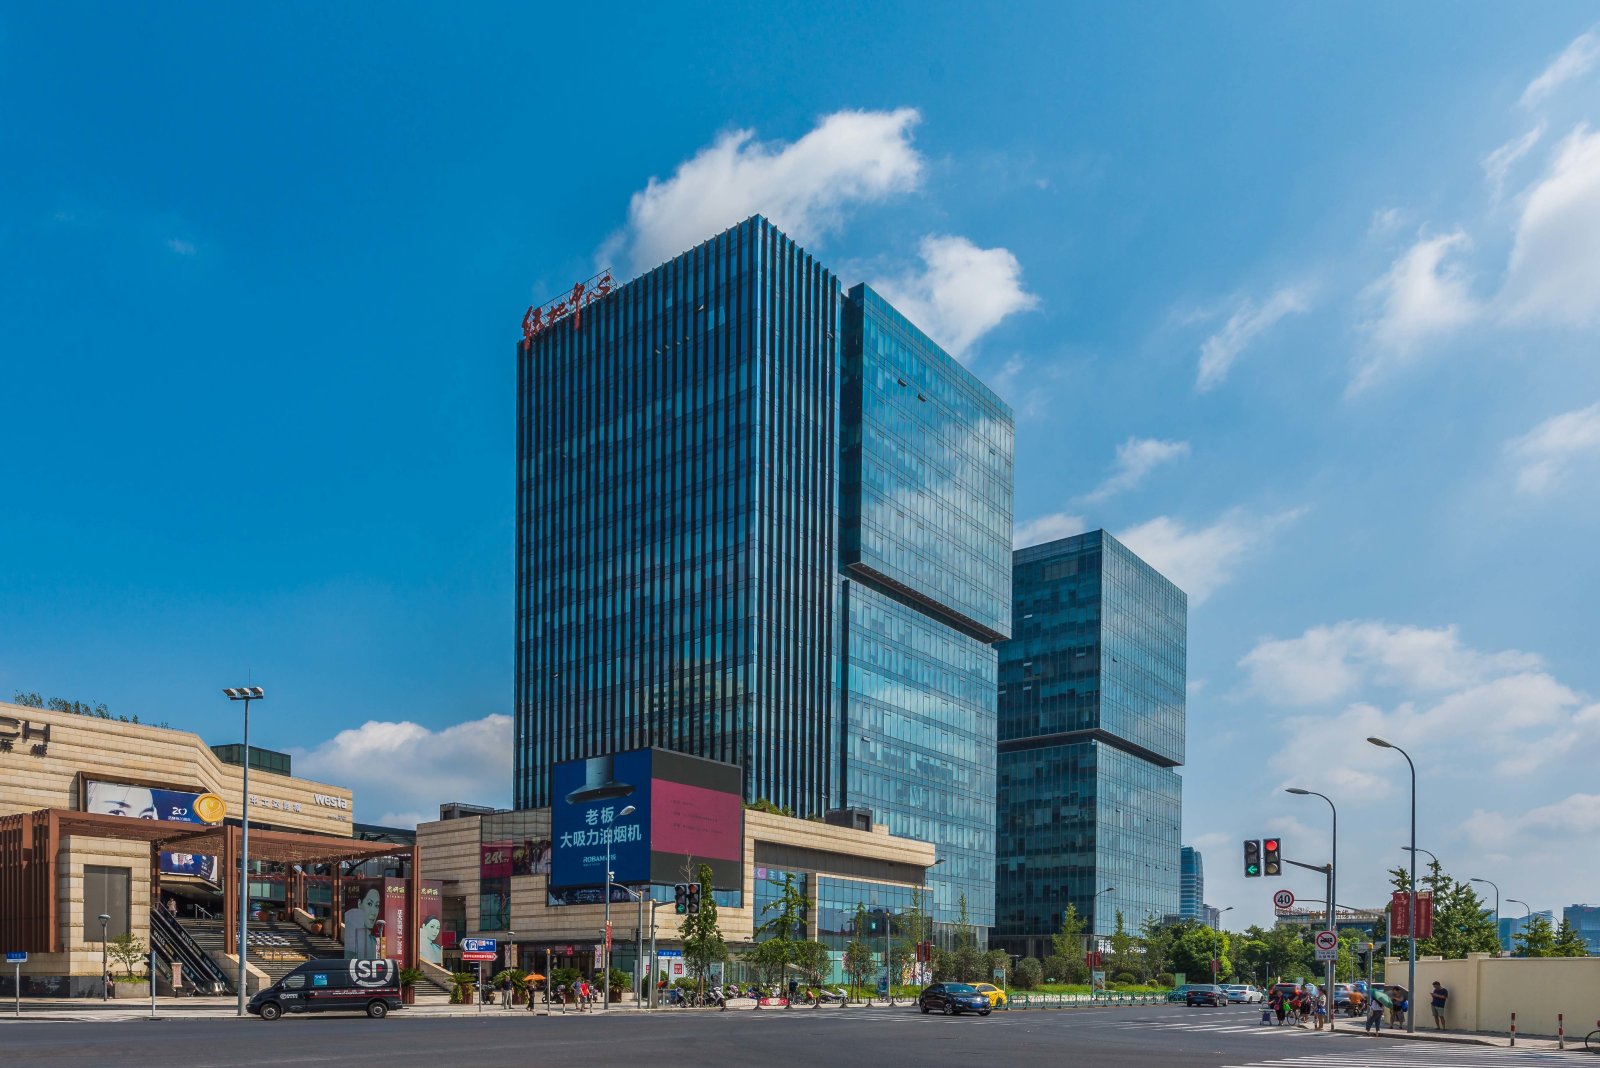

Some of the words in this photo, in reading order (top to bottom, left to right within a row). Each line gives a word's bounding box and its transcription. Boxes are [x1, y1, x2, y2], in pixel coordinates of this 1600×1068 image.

[585, 806, 615, 826] 老板
[560, 824, 642, 848] 大吸力油烟机
[1277, 894, 1291, 904] 40
[357, 959, 385, 978] SF
